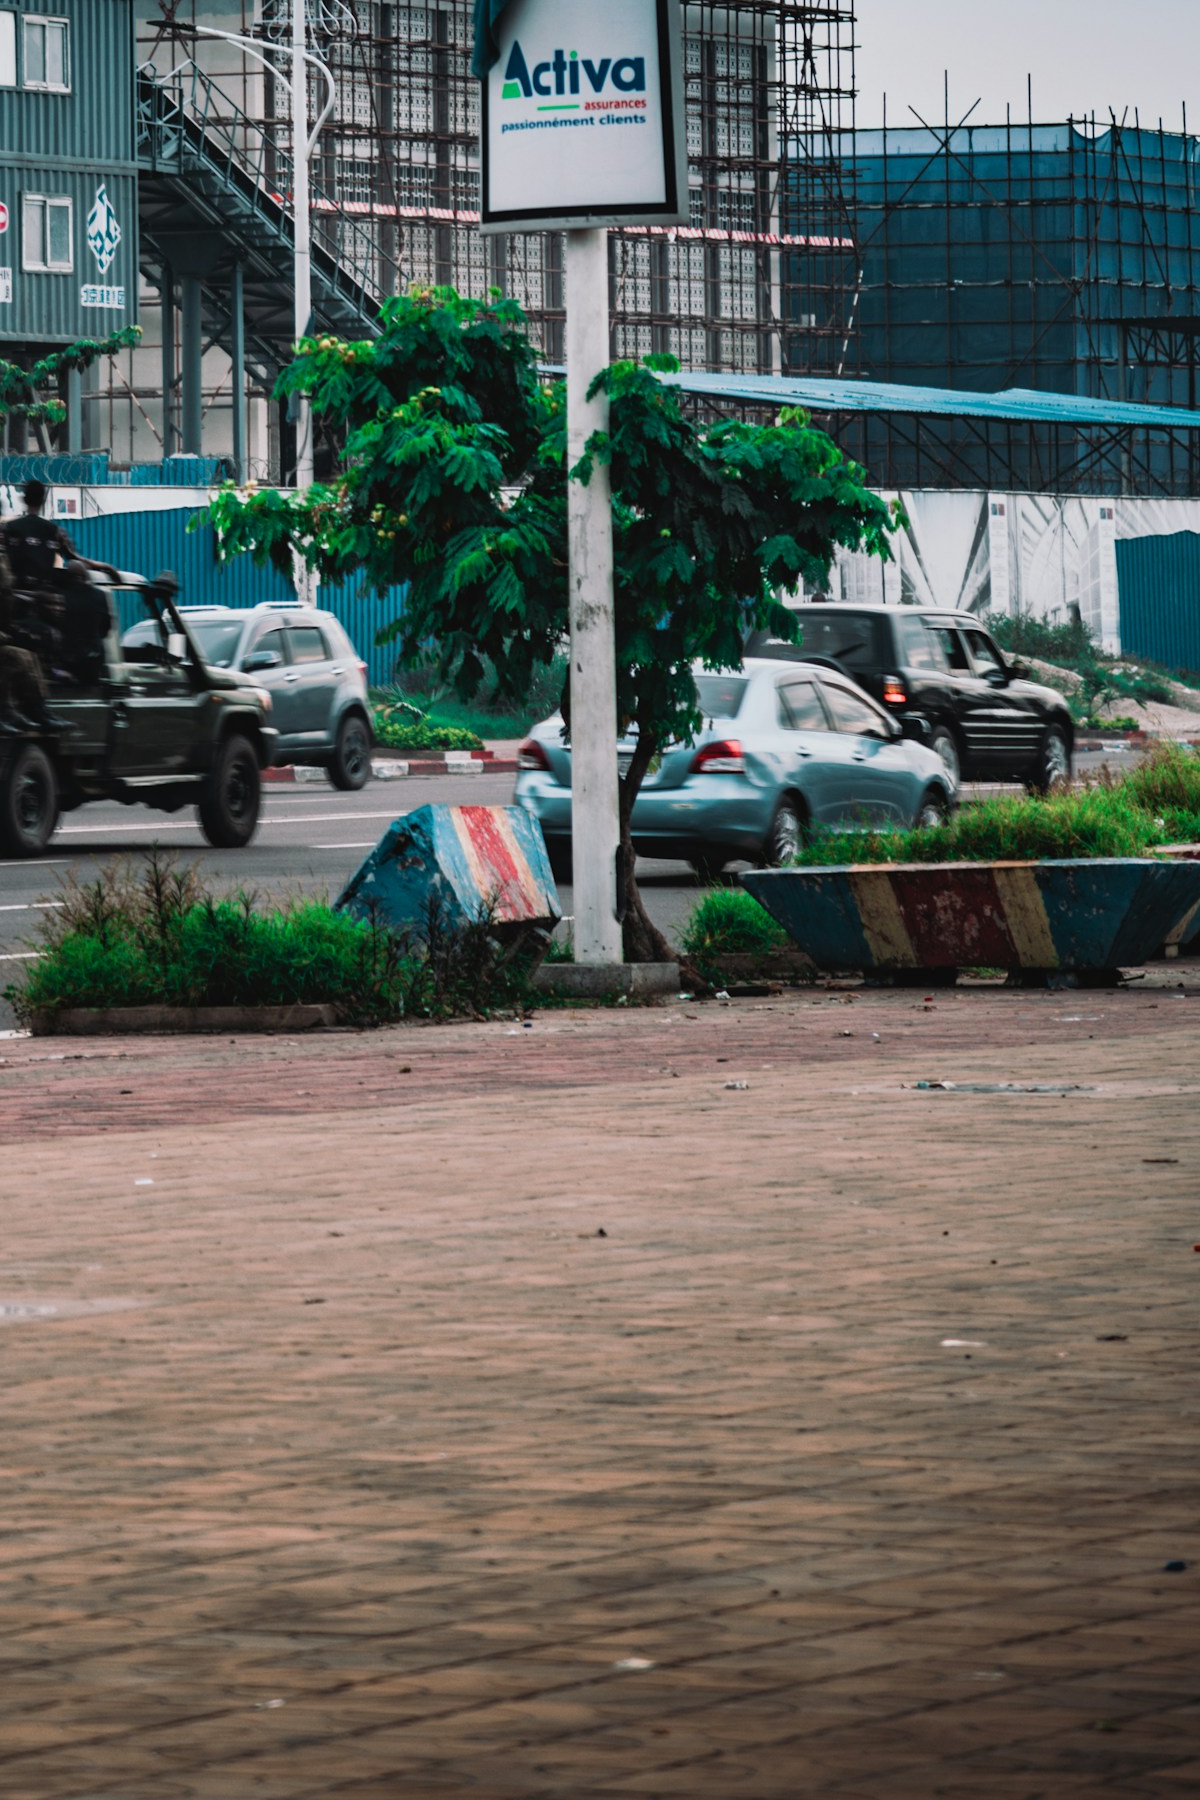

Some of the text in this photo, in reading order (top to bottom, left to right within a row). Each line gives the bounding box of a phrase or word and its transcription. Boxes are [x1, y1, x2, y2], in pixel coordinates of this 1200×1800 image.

[501, 39, 645, 99] Activa
[584, 98, 647, 111] assurances
[501, 114, 646, 134] passionnément clients
